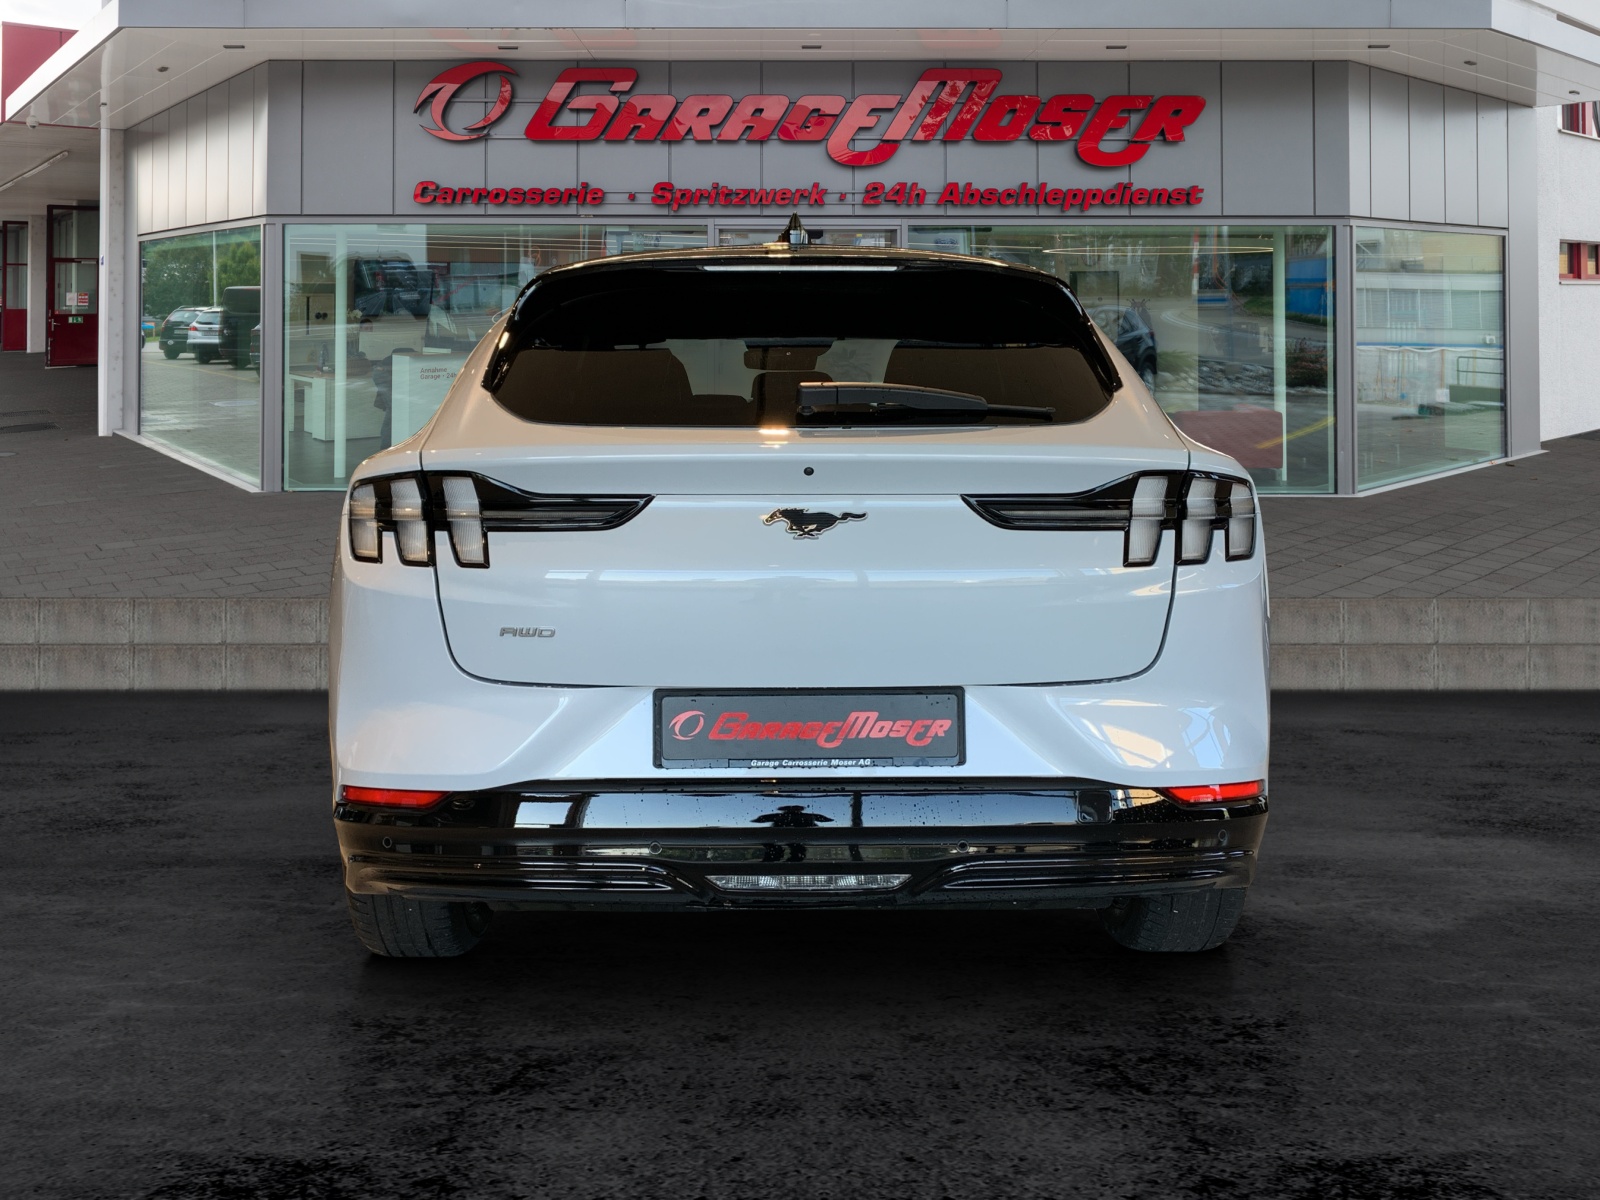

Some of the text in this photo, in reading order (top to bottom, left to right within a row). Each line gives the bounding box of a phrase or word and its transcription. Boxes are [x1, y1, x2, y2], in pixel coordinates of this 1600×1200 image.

[413, 181, 1204, 211] Carrosserie Spritzwerk 24h Abschleppdienst
[500, 626, 556, 638] AWD
